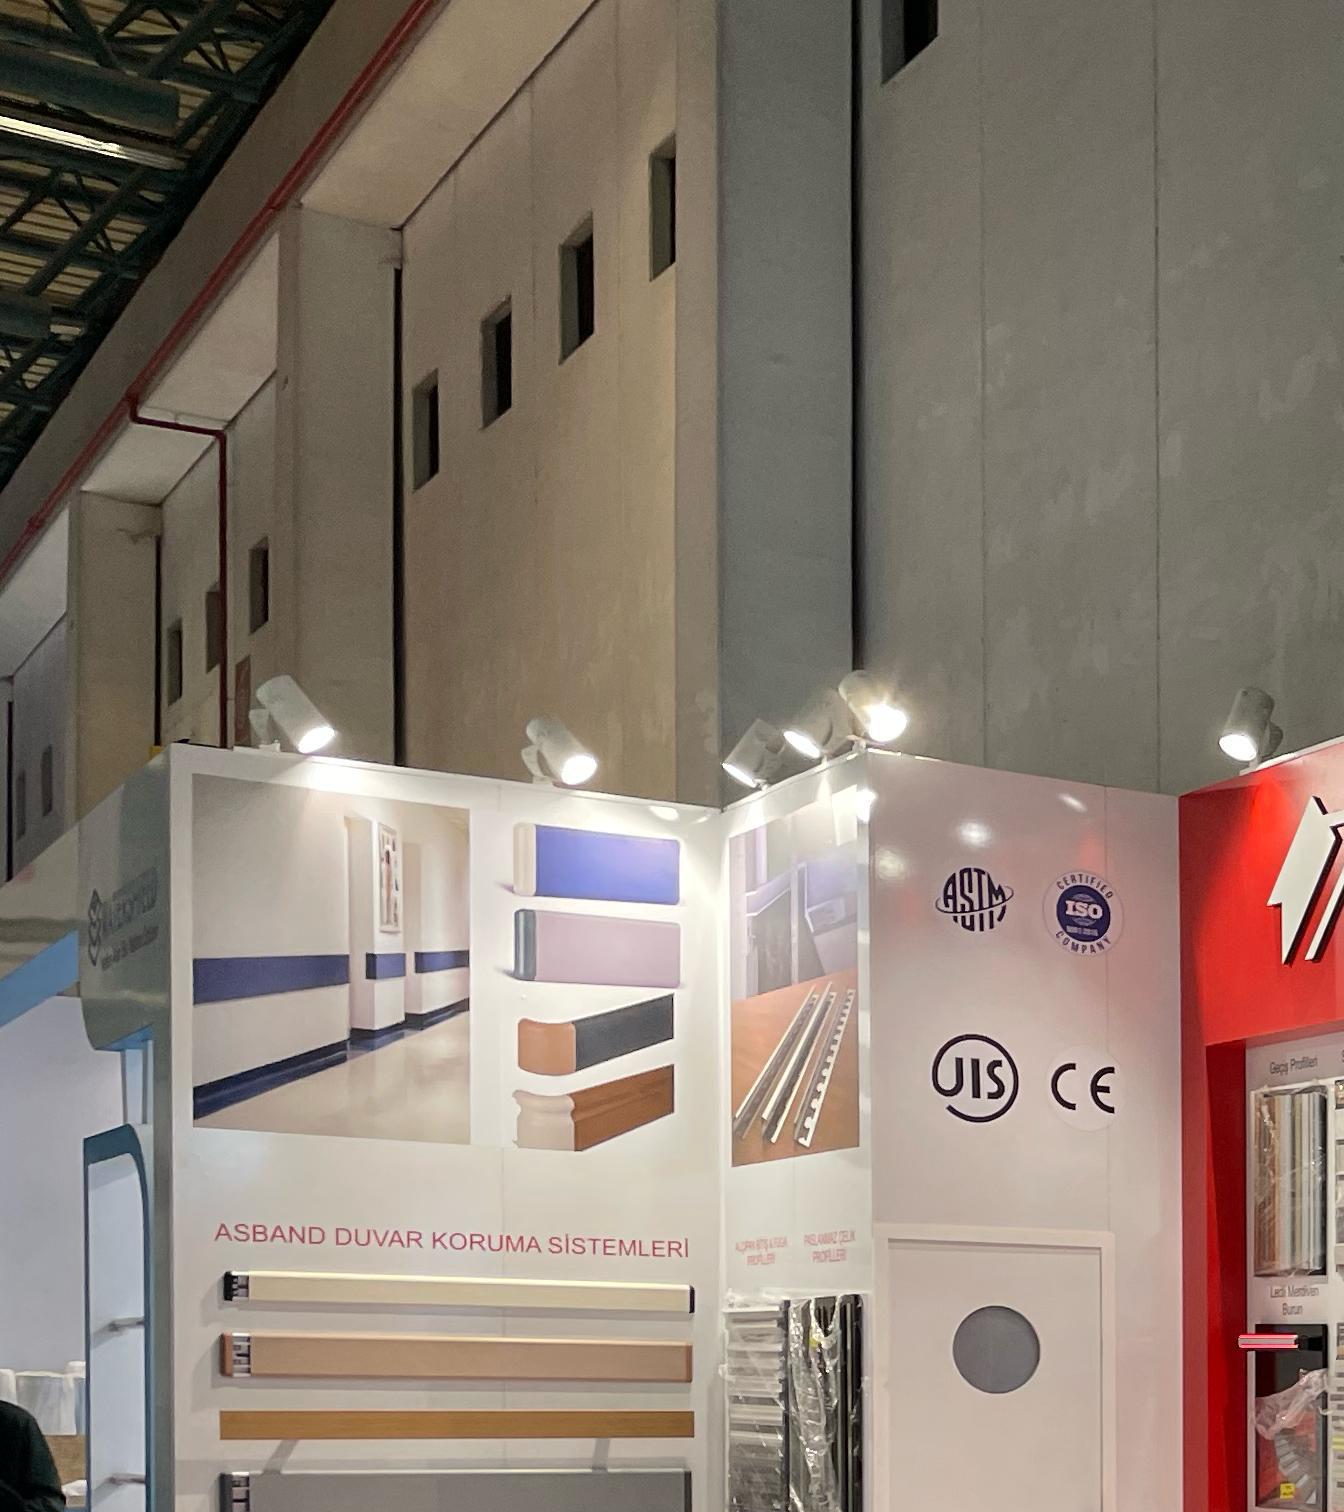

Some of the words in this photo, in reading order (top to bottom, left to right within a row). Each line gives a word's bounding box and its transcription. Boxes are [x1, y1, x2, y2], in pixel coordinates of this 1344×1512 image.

[941, 866, 1009, 932] ASTM
[1055, 873, 1114, 900] CERTIFIED
[1065, 899, 1104, 920] ISO
[1055, 930, 1112, 954] COMPANY
[933, 1056, 1006, 1101] JIS
[1050, 1062, 1116, 1114] CE
[214, 1222, 326, 1245] ASBAND
[335, 1226, 424, 1249] DUVAR
[431, 1230, 542, 1254] KORUMA
[547, 1232, 689, 1258] SİSTEMLERİ
[1282, 1303, 1303, 1316] Burun
